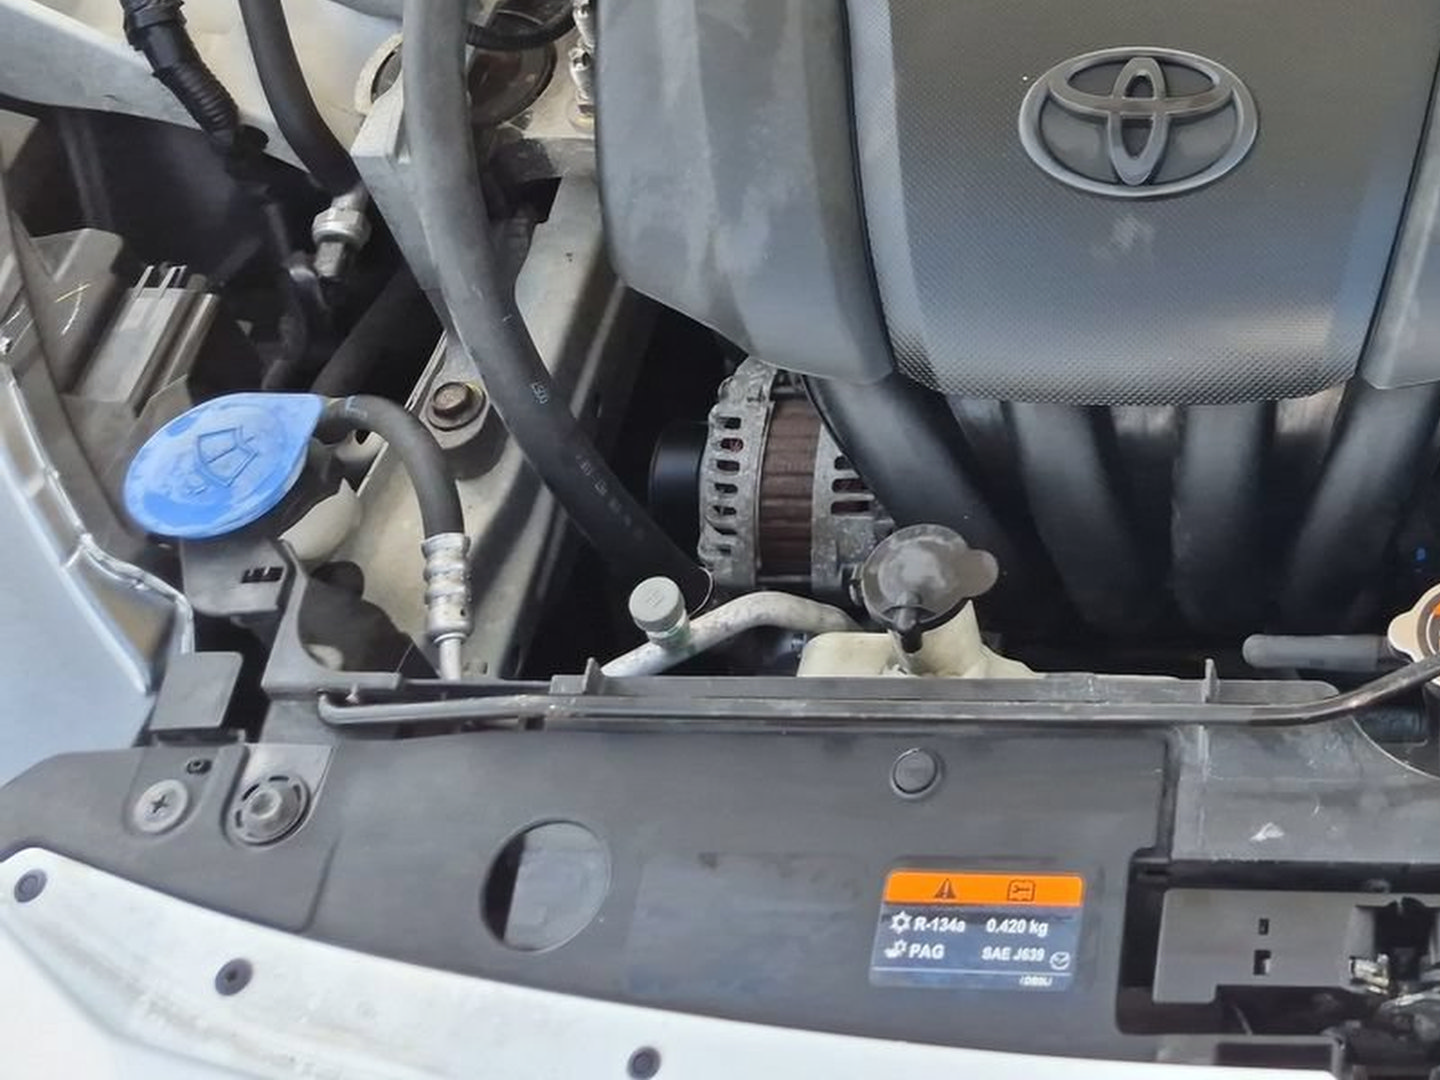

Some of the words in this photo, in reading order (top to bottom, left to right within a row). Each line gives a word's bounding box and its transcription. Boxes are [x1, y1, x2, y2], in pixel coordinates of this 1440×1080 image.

[913, 916, 966, 933] R-134a
[1029, 918, 1049, 938] kg
[908, 942, 945, 960] PAG
[981, 945, 1011, 961] SAE
[1012, 946, 1046, 962] J639
